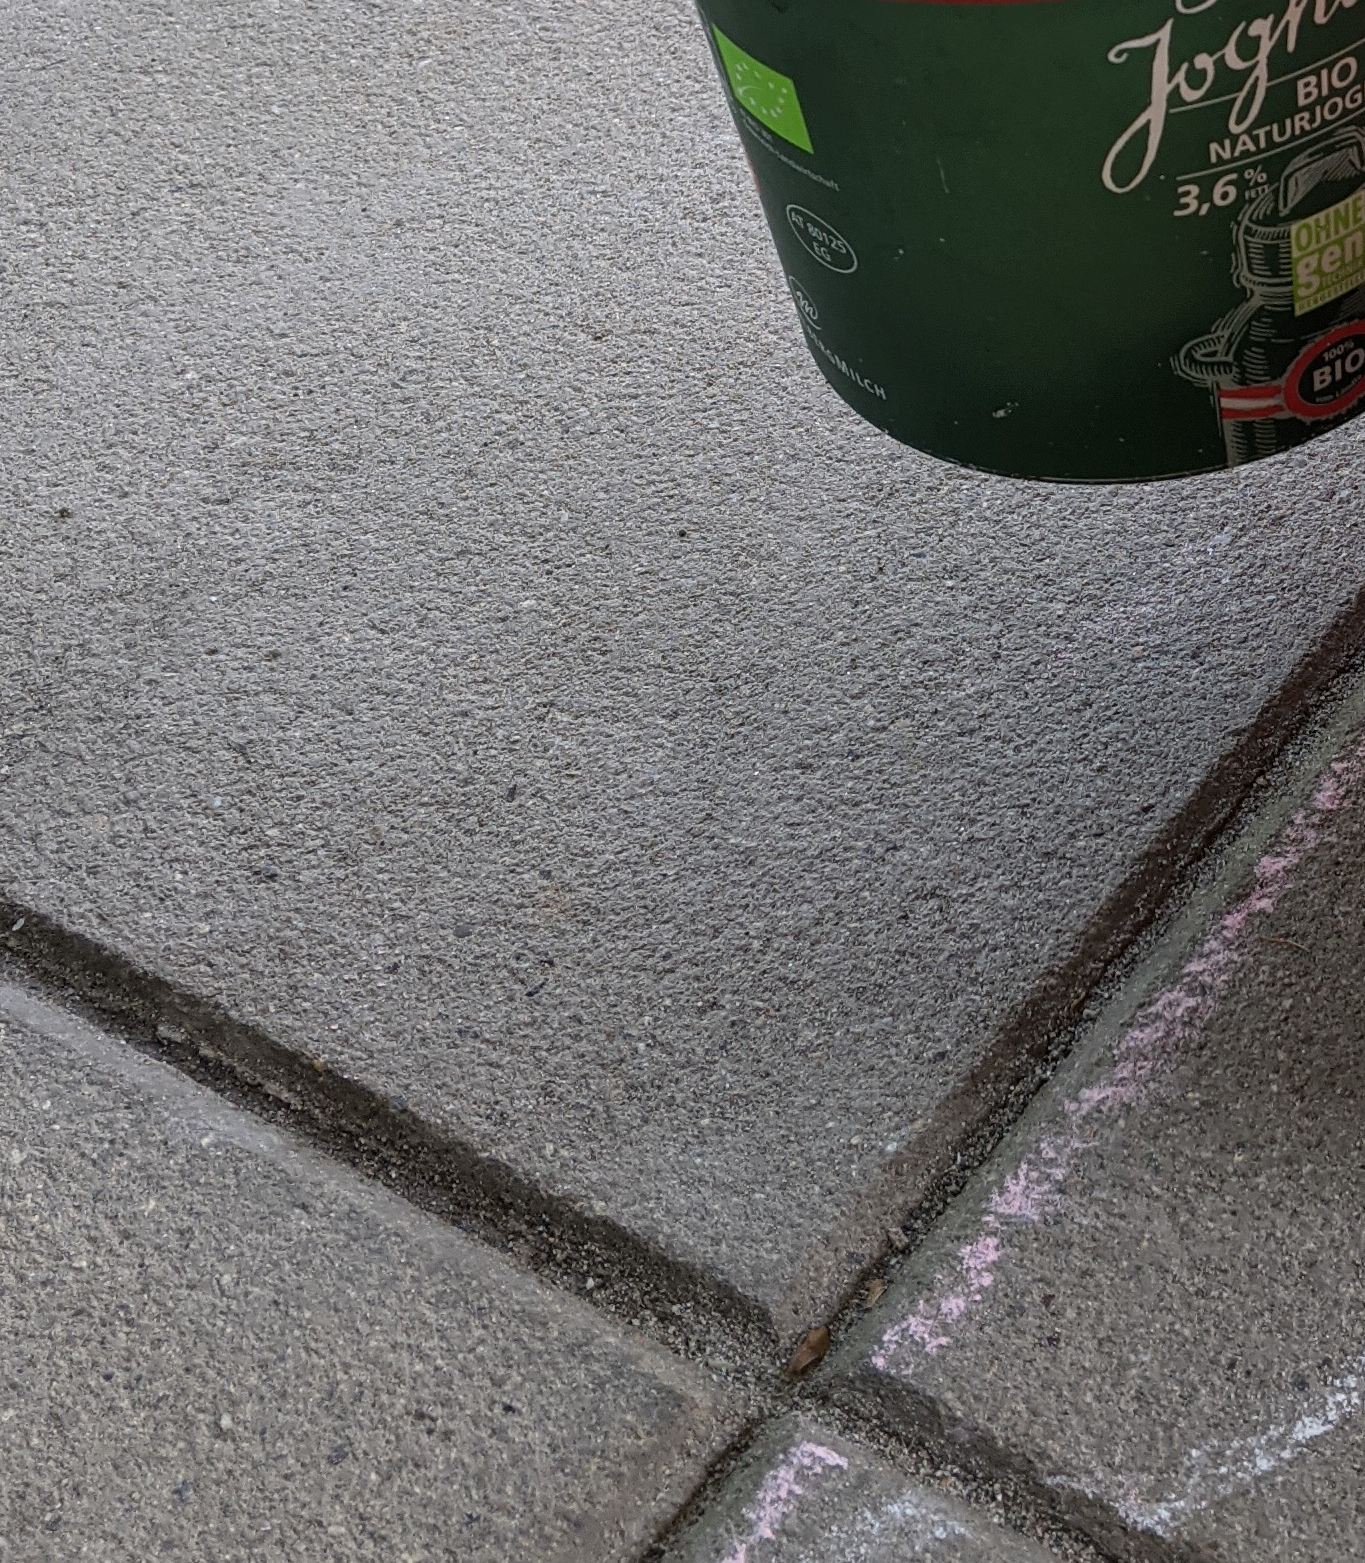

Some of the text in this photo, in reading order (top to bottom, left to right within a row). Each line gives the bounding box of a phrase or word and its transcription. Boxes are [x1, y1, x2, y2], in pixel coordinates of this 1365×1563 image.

[1296, 55, 1359, 108] BIO
[1294, 196, 1364, 253] OHNE
[812, 240, 832, 262] EG
[1296, 230, 1364, 298] gen
[1312, 347, 1365, 393] BIO
[1322, 339, 1355, 363] 100%
